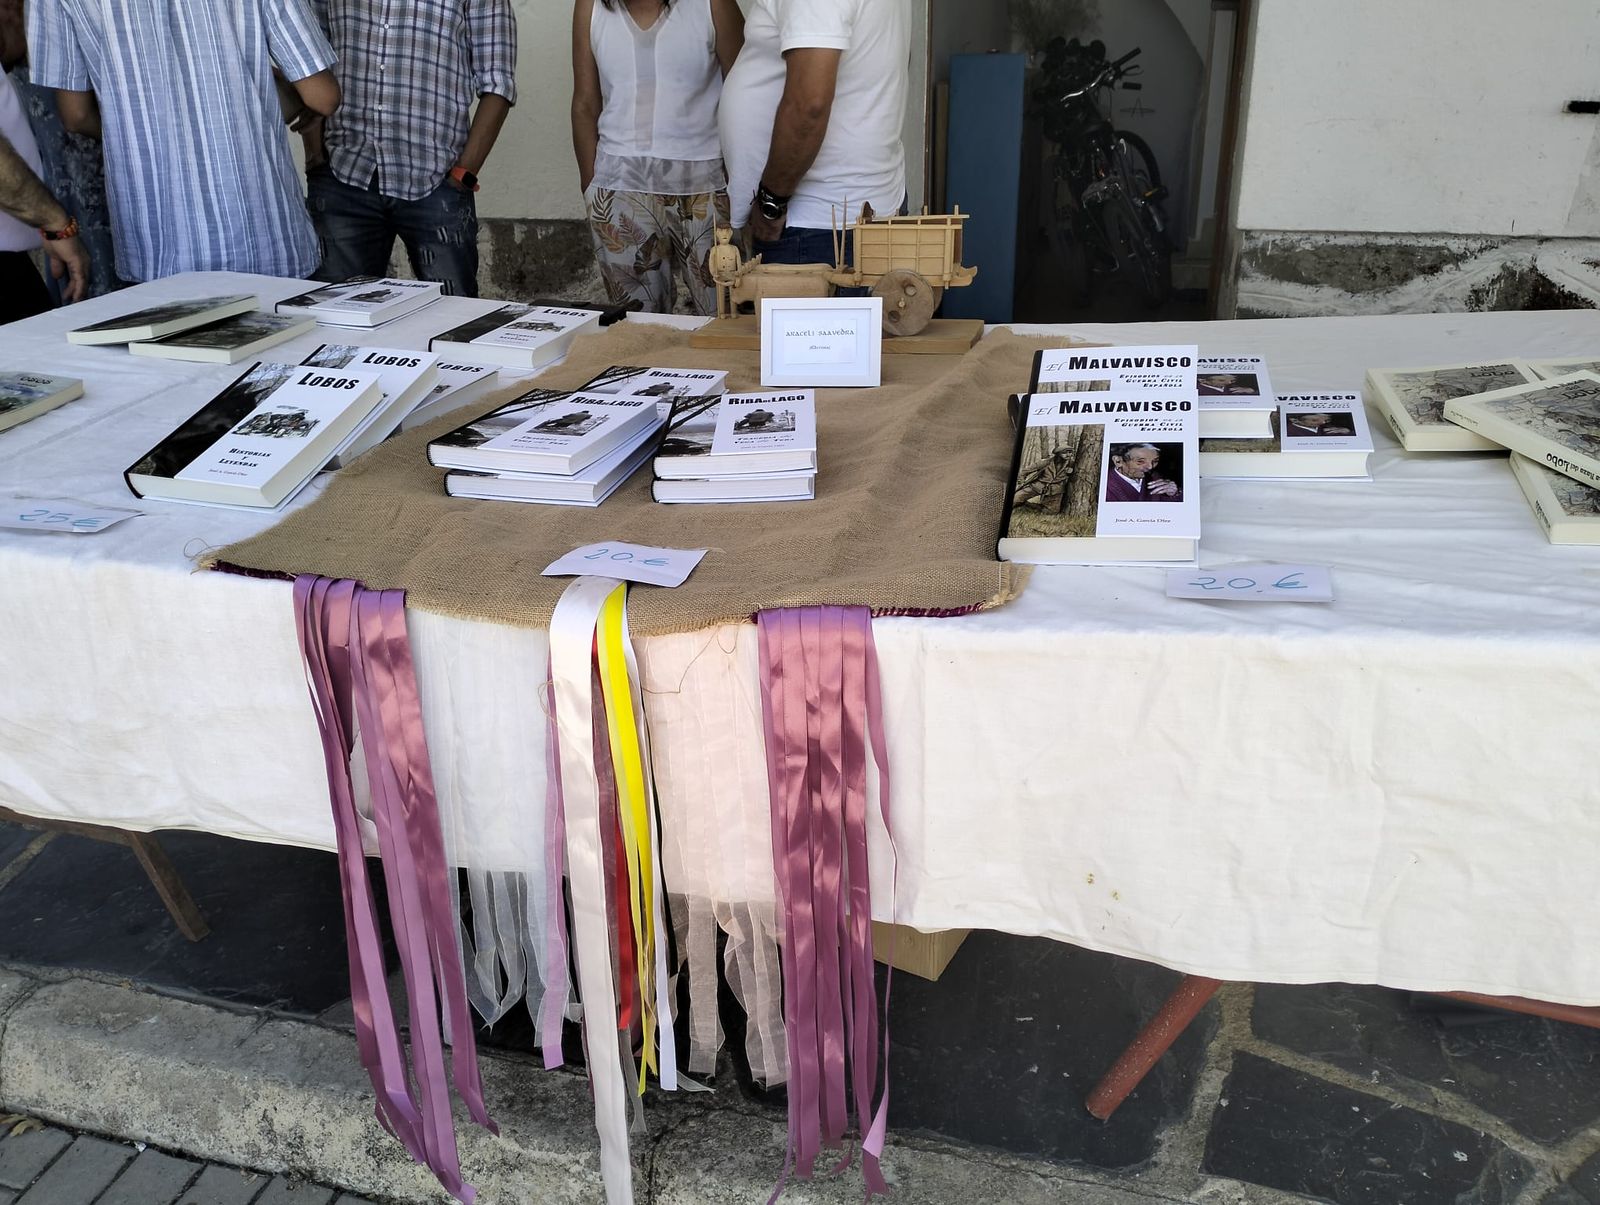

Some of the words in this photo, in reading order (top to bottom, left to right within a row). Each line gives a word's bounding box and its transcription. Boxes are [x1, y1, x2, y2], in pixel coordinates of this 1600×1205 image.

[362, 352, 422, 368] LOBOS
[1068, 356, 1192, 370] MALVAVISCO
[297, 372, 360, 390] LOBOS
[1058, 400, 1192, 415] MALVAVISCO
[1546, 452, 1571, 473] Lobo
